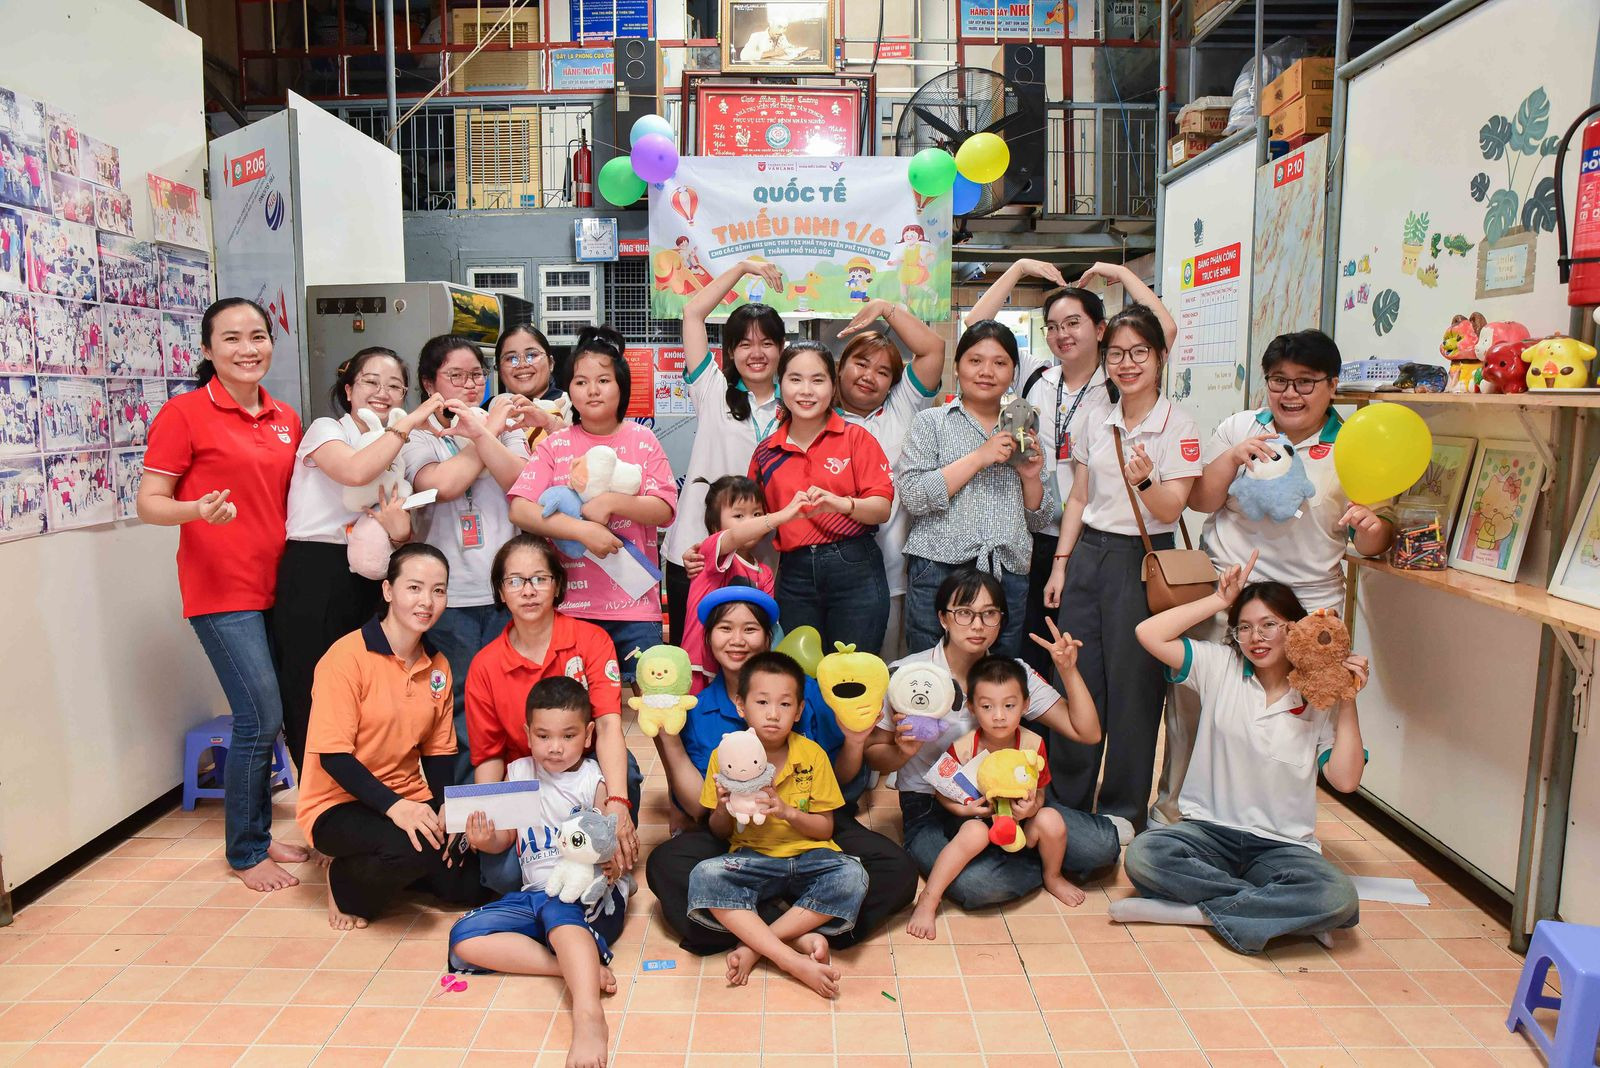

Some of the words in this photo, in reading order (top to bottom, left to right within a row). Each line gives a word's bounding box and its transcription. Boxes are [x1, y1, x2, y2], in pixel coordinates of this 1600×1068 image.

[970, 7, 988, 16] HÀNG
[245, 155, 265, 176] P.06
[1287, 158, 1303, 178] P.10
[753, 177, 815, 203] QUỐC
[818, 177, 847, 203] TẾ
[711, 207, 789, 245] THIẾU
[794, 216, 839, 237] NHI
[844, 221, 886, 246] 1/6
[768, 247, 789, 255] THÀNH
[791, 245, 804, 254] PHỐ
[805, 246, 818, 254] THỦ
[1197, 258, 1210, 270] BẢNG
[1210, 252, 1223, 265] PHÂN
[1223, 250, 1237, 261] CÔNG
[1202, 269, 1214, 280] TRỰC
[1213, 266, 1220, 279] VỆ
[1219, 265, 1231, 277] SINH
[270, 424, 290, 433] VLU
